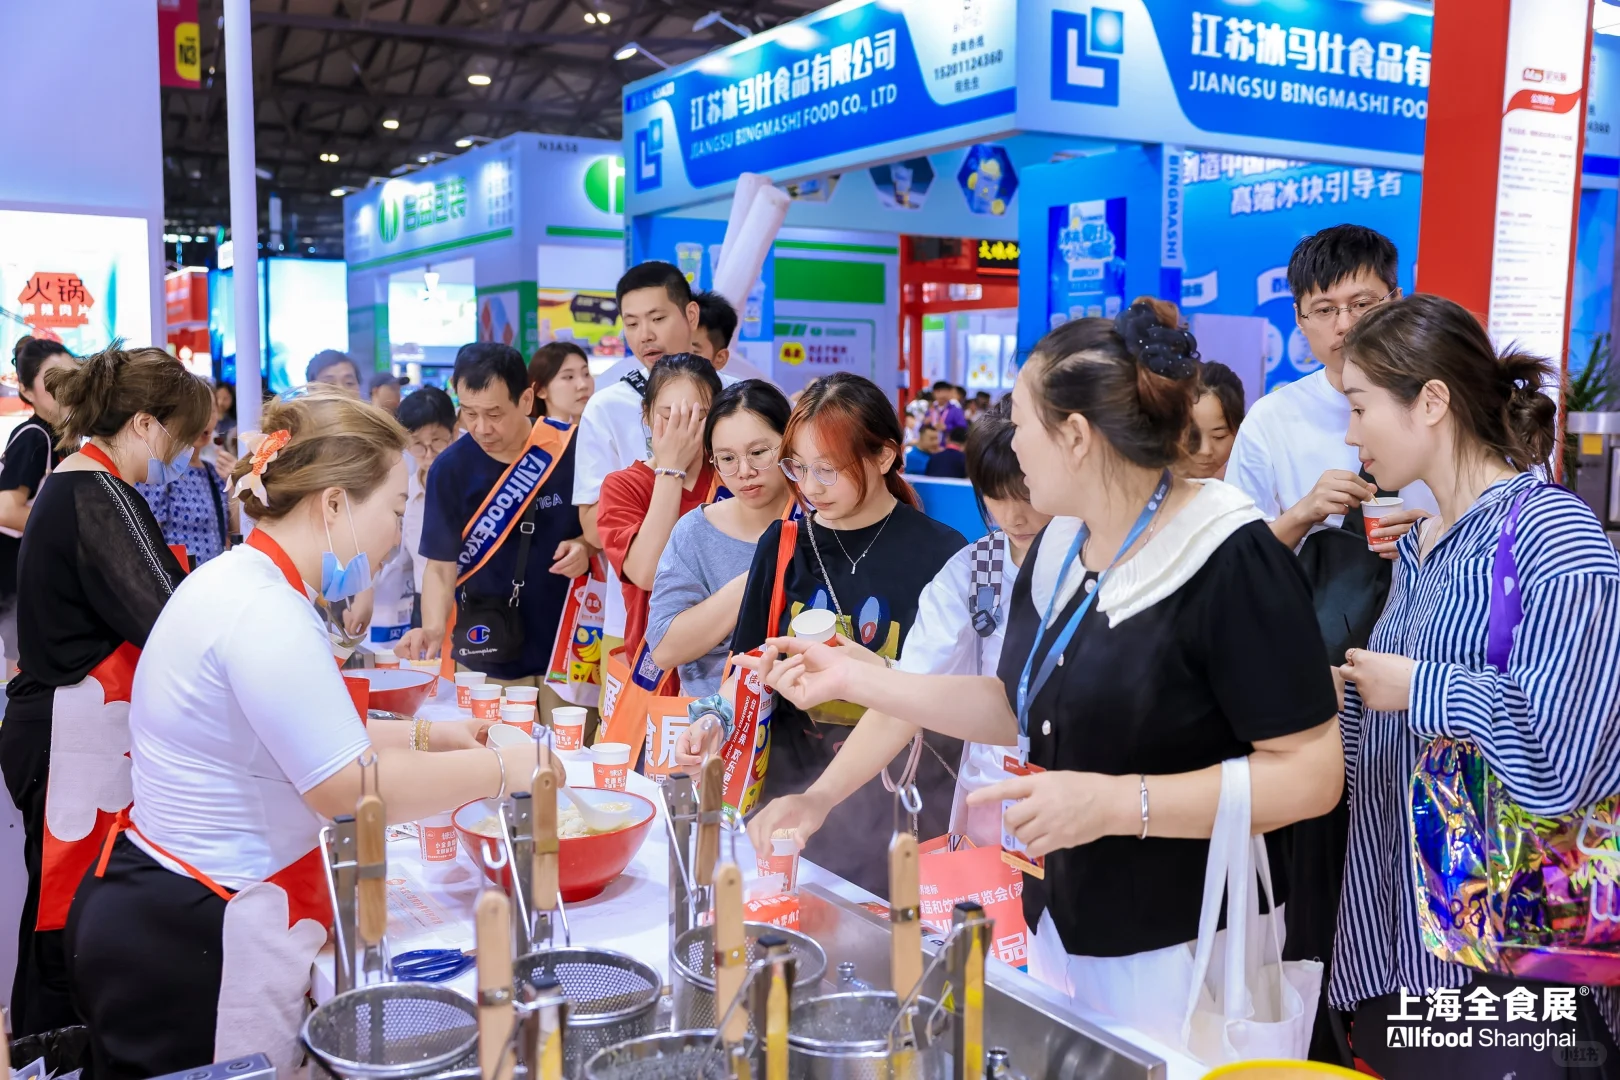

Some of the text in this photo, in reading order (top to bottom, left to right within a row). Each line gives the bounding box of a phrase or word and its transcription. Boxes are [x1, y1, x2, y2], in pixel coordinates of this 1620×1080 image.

[1191, 11, 1431, 87] 江苏冰马仕食品有
[690, 28, 897, 132] 江苏冰马仕食品有限公司
[1189, 70, 1276, 98] JIANGSU
[1281, 83, 1389, 115] BINGMASHI
[690, 130, 734, 160] JIANGSU
[735, 111, 801, 147] BINGMASHI
[804, 99, 839, 126] FOOD
[871, 83, 897, 109] LTD
[1166, 153, 1180, 260] BINGMASHI
[1231, 168, 1403, 215] 高端冰块引导者
[26, 277, 85, 303] 火锅
[459, 648, 498, 656] Champion
